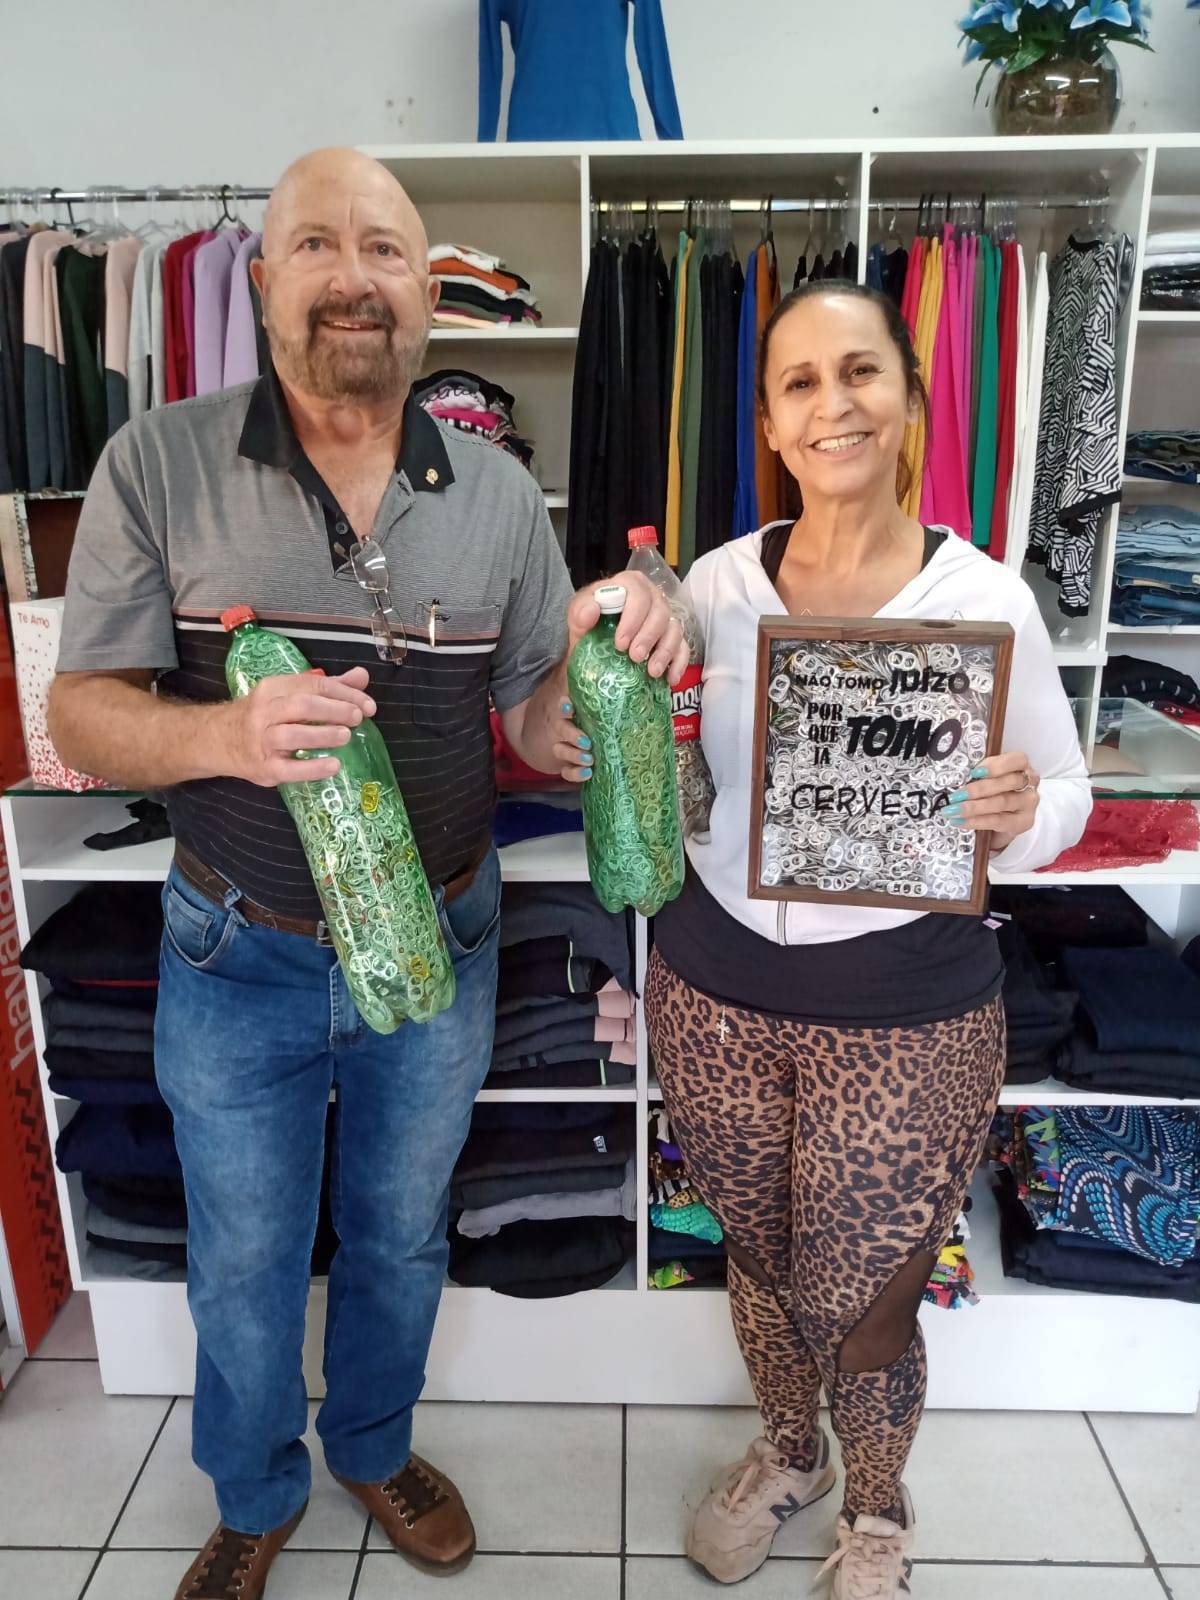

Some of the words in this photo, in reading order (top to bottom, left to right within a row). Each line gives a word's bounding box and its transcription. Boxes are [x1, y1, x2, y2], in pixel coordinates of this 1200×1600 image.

[17, 612, 28, 624] Te
[31, 613, 50, 628] Amo
[795, 672, 832, 687] NÃO
[836, 676, 884, 690] TOMO
[806, 702, 844, 721] POR
[808, 723, 840, 744] QUE
[846, 714, 963, 762] TOMO
[790, 783, 951, 819] CERVEJA
[768, 1492, 801, 1523] N
